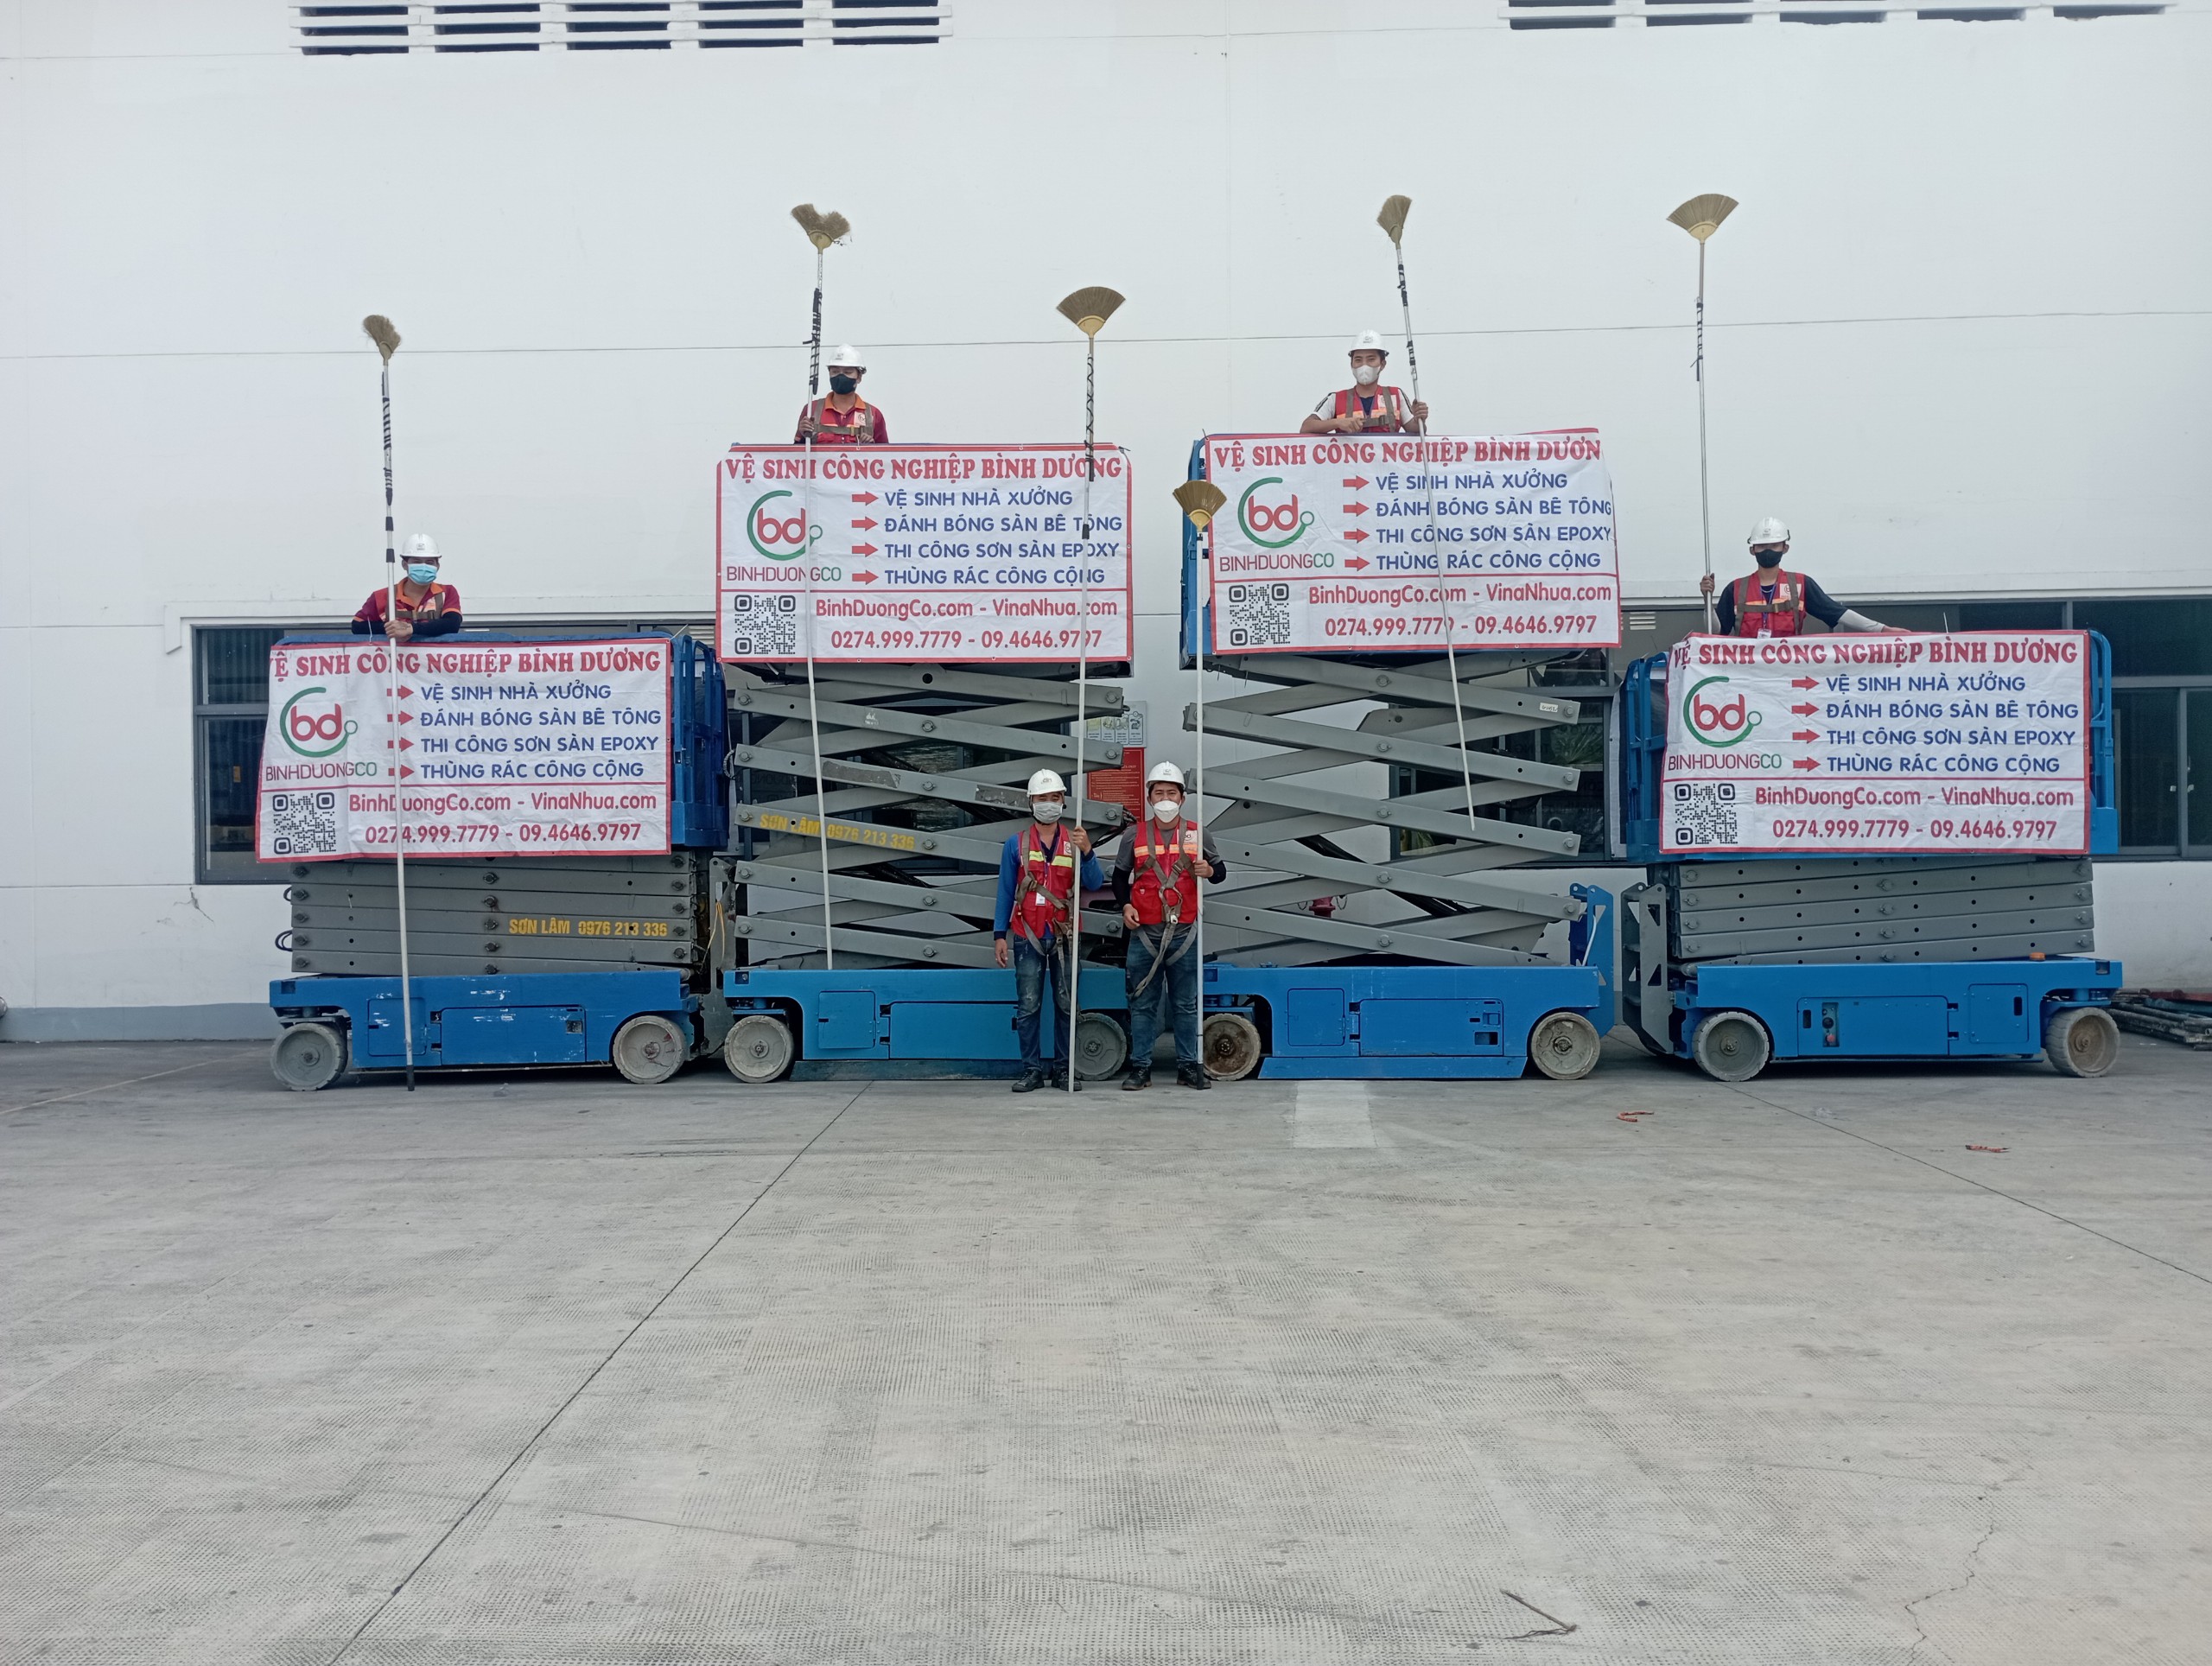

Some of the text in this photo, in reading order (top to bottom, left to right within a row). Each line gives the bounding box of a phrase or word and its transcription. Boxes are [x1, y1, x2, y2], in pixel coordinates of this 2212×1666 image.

[1214, 441, 1244, 472] VỆ
[1253, 445, 1306, 466] SINH
[1313, 437, 1376, 464] CÔNG
[1382, 437, 1468, 467] NGHIỆP
[1474, 435, 1530, 461] BÌNH
[726, 459, 755, 484] VỆ
[763, 456, 817, 479] SINH
[823, 453, 885, 480] CÔNG
[891, 453, 975, 484] NGHIỆP
[982, 453, 1036, 479] BÌNH
[1376, 468, 1567, 493] VỆ SINH NHÀ XƯỞNG
[885, 486, 1072, 509] VỆ SINH NHÀ XƯỞNG
[1376, 497, 1611, 517] ĐÁNH BÓNG SÀN BÊ TÔNG
[884, 512, 1122, 532] ĐÁNH BÓNG SÀN BÊ TÔNG
[1376, 523, 1611, 543] THI CÔNG SƠN SÀN EPOXY
[885, 539, 1119, 558] THI CÔNG SƠN SÀN EPOXY
[1220, 553, 1334, 571] BINHDUONGCO
[1376, 550, 1600, 570] THÙNG RÁC CÔNG CỘNG
[727, 566, 841, 582] BINHDUONGCO
[885, 566, 1104, 587] THÙNG RÁC CÔNG CỘNG
[1309, 585, 1465, 607] BinhDuongCo.com
[1486, 582, 1611, 601] VinaNhua.com
[817, 599, 972, 621] BinhDuongCo.com
[1325, 617, 1454, 636] 0274.999.7779
[1475, 615, 1597, 634] 09.4646.9797
[831, 631, 962, 648] 0274.999.7779
[1699, 644, 1755, 667] SINH
[1761, 639, 1827, 664] CÔNG
[1833, 638, 1923, 670] NGHIỆP
[1929, 636, 1986, 663] BÌNH
[1993, 638, 2077, 663] DƯƠNG
[270, 647, 660, 682] Ệ SINH CÔNG NGHIỆP BÌNH DƯƠNG
[421, 679, 611, 703] VỆ SINH NHÀ XƯỞNG
[1826, 671, 2025, 695] VỆ SINH NHÀ XƯỞNG
[420, 707, 661, 726] ĐÁNH BÓNG SÀN BÊ TÔNG
[1826, 699, 2078, 718] ĐÁNH BÓNG SÀN BÊ TÔNG
[421, 734, 658, 753] THI CÔNG SƠN SÀN EPOXY
[1827, 727, 2075, 745] THI CÔNG SƠN SÀN EPOXY
[266, 762, 377, 781] BINHDUONGCO
[421, 760, 644, 780] THÙNG RÁC CÔNG CỘNG
[1669, 754, 1782, 771] BINHDUONGCO
[1827, 753, 2059, 775] THÙNG RÁC CÔNG CỘNG
[531, 792, 656, 810] VinaNhua.com
[1756, 786, 1921, 810] BinhDuongCo.com
[1942, 786, 2073, 805] VinaNhua.com
[365, 825, 499, 843] 0274.999.7779
[520, 823, 641, 842] 09.4646.9797
[864, 830, 887, 844] 213
[1773, 820, 1909, 838] 0274.999.7779
[1931, 820, 2058, 838] 09.4646.9797
[511, 919, 667, 935] SƠN LÂM 0976 213 336
